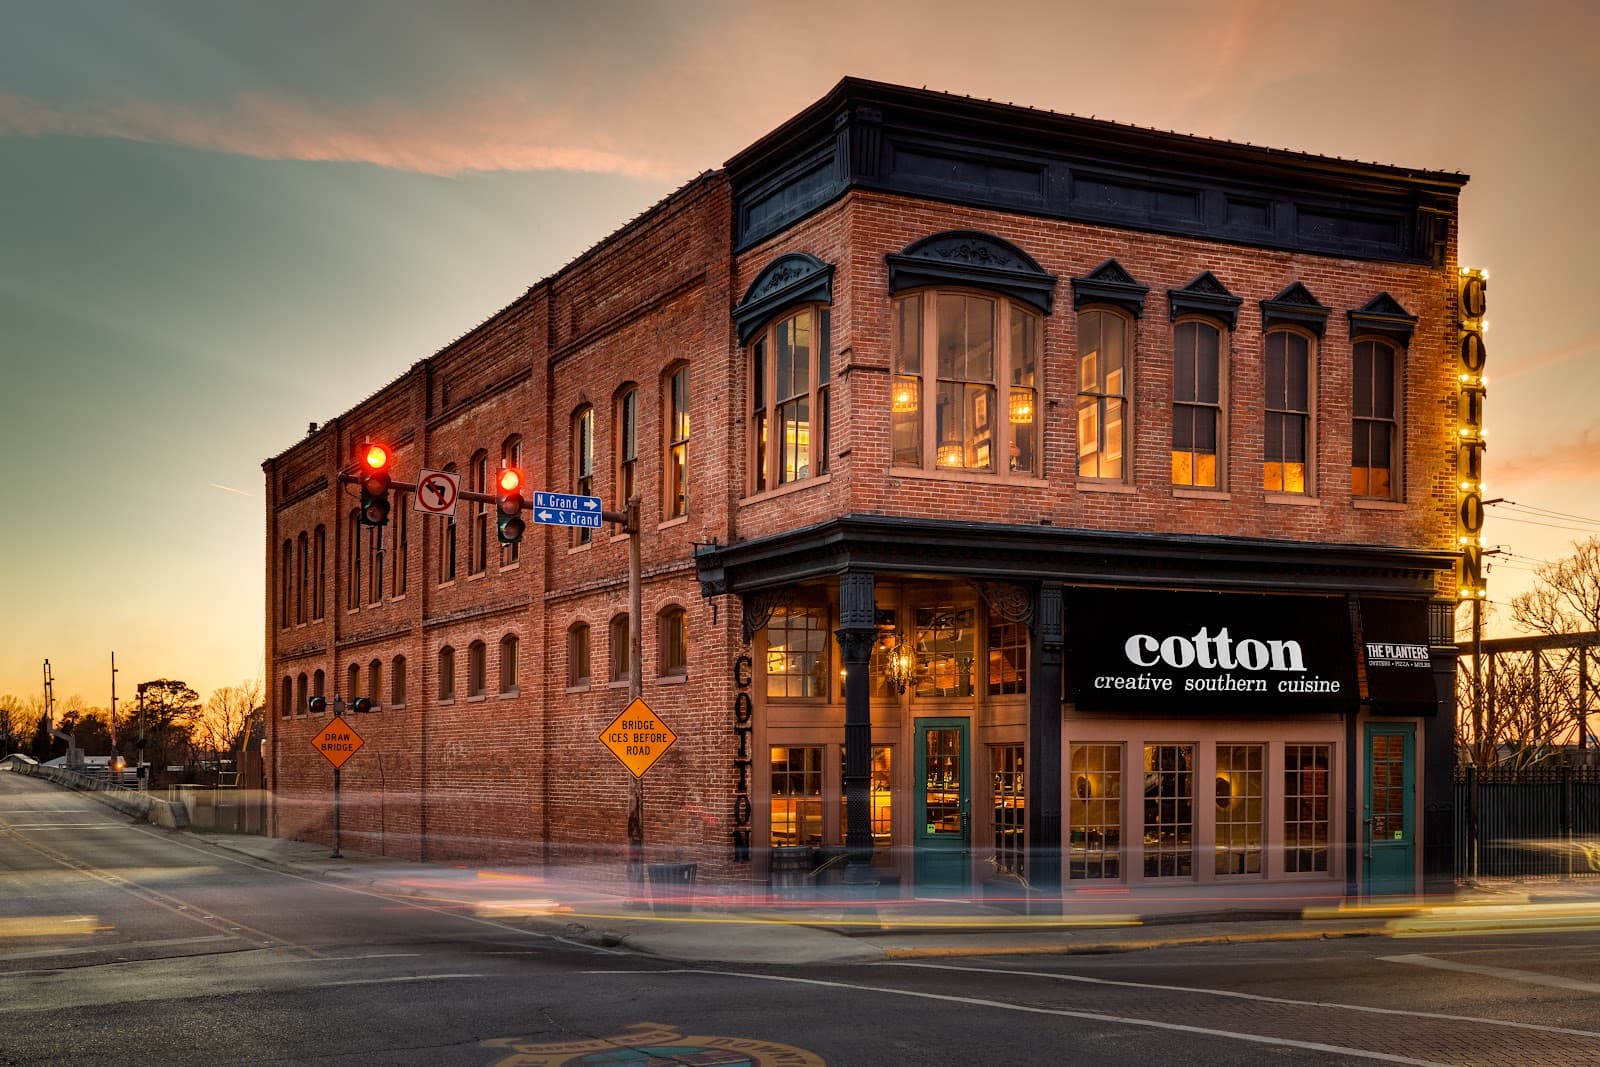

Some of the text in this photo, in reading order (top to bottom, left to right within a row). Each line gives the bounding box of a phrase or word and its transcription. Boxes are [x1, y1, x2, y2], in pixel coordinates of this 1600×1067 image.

[1460, 275, 1487, 587] COTTON
[537, 494, 578, 510] N. Grand
[559, 511, 599, 526] S. Grand
[1125, 626, 1307, 672] cotton
[1366, 644, 1429, 660] THE PLANTERS
[1094, 672, 1341, 693] creative southern cuisine
[622, 720, 655, 730] BRIDGE
[608, 733, 668, 743] ICES BEFORE
[321, 744, 353, 752] BRIDGE
[626, 746, 651, 756] ROAD
[733, 655, 753, 863] COTTON
